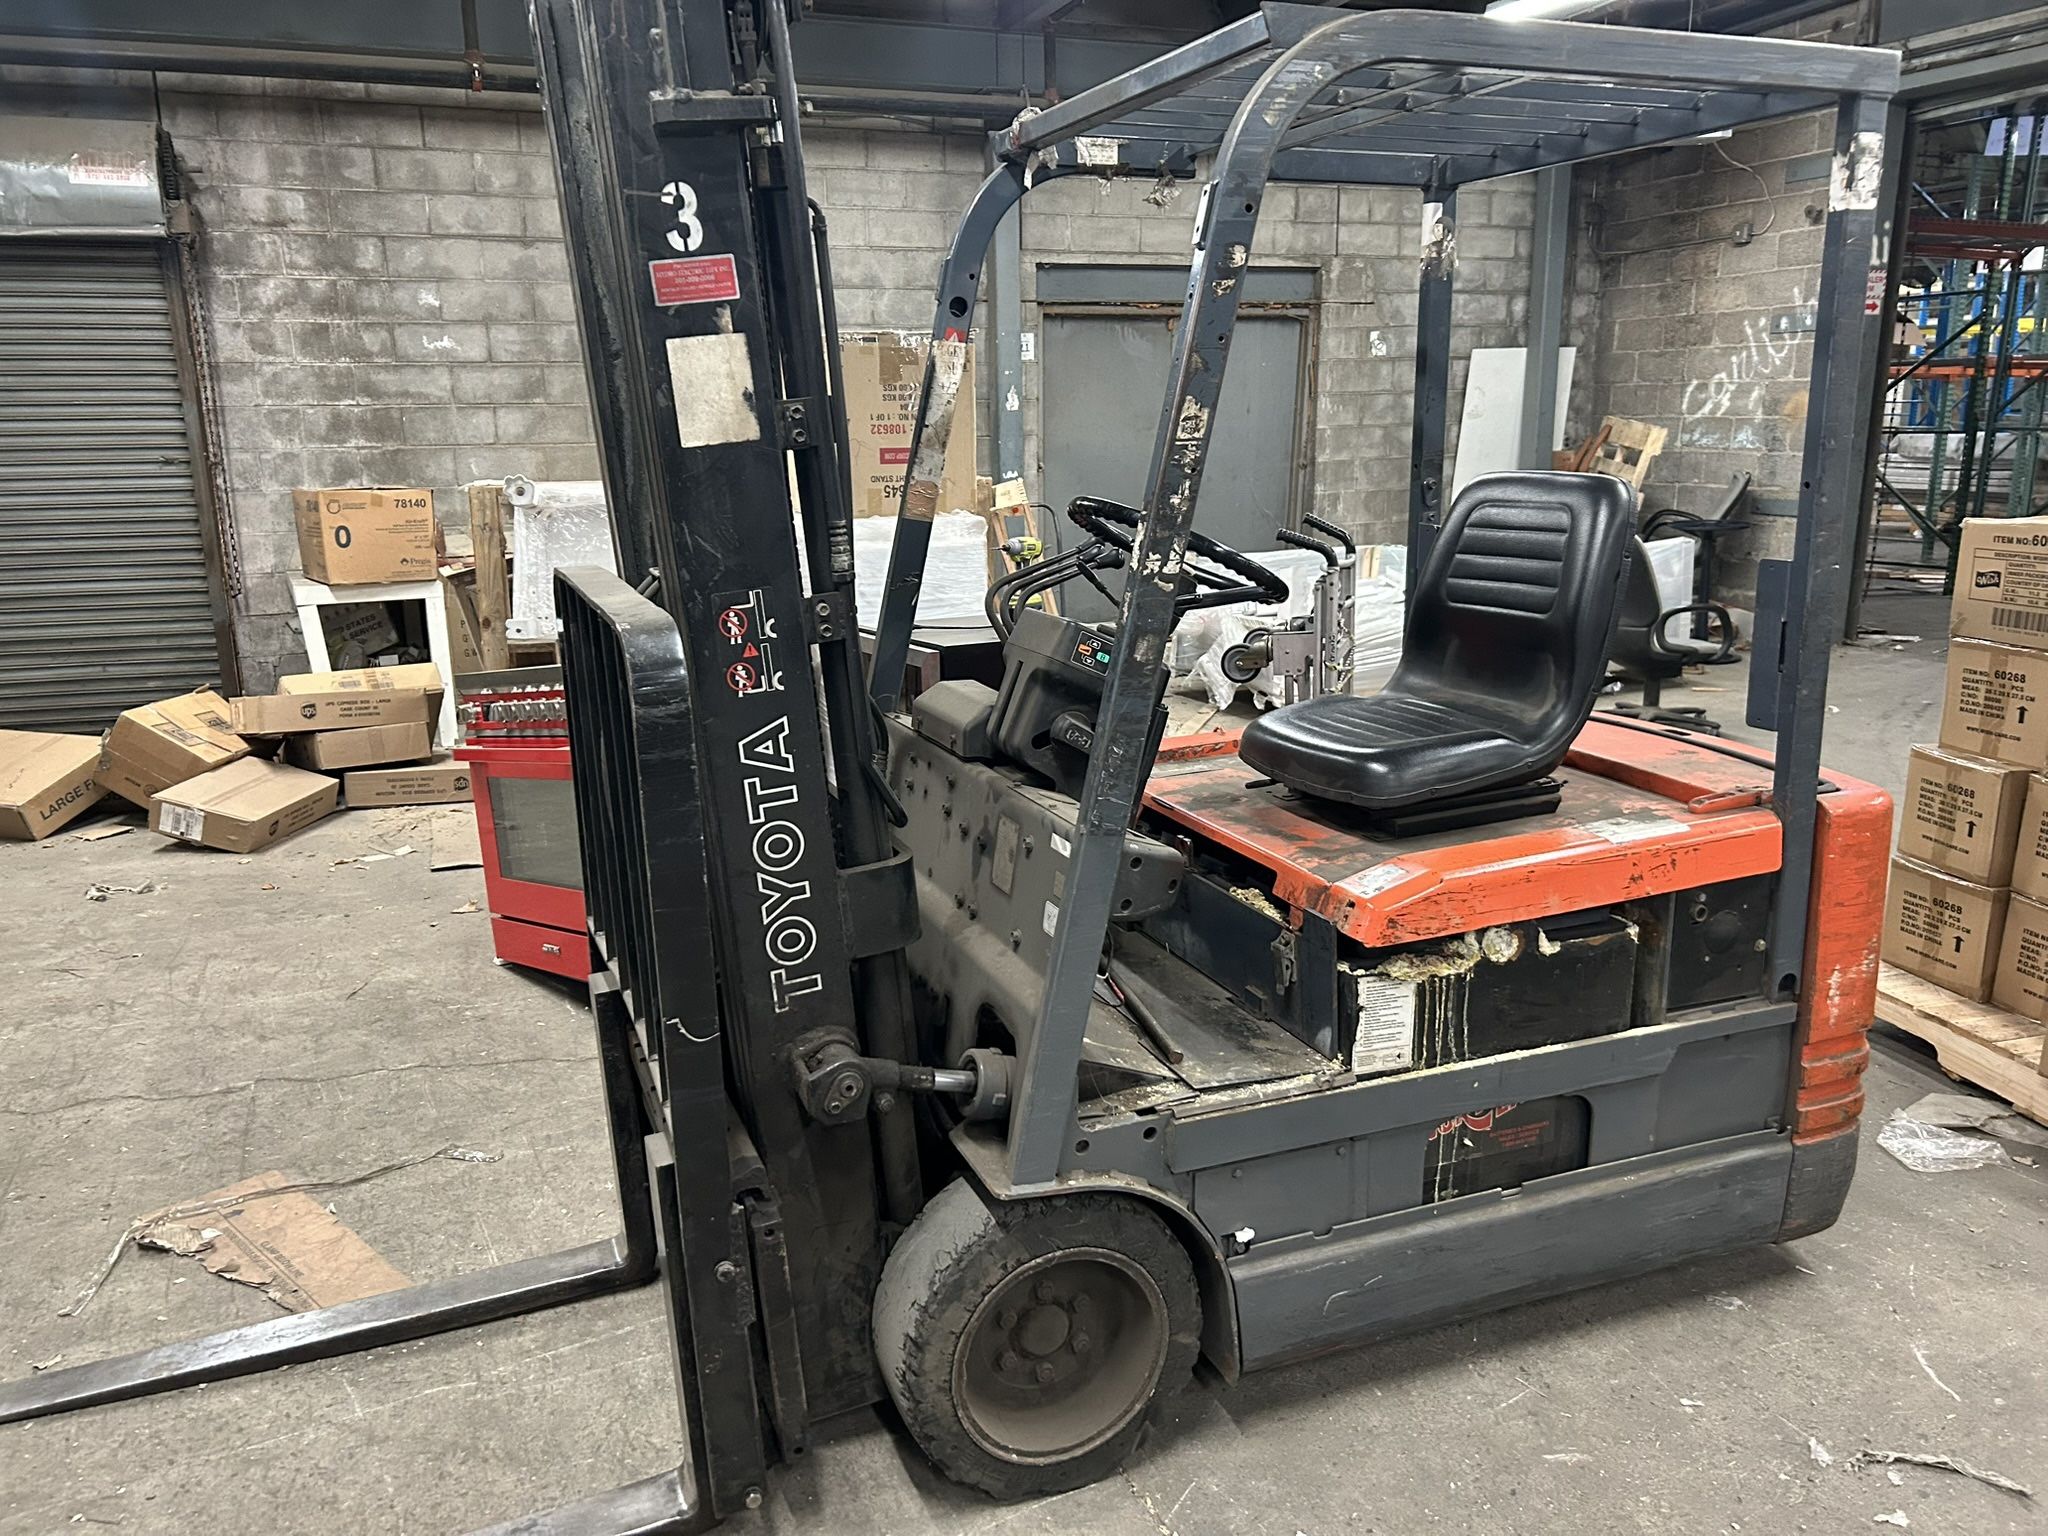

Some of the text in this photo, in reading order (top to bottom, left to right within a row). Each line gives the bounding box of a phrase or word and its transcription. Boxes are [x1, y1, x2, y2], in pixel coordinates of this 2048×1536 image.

[661, 181, 703, 252] 3
[870, 424, 907, 434] 108632
[394, 498, 426, 508] 78140
[335, 525, 352, 548] 0
[1993, 535, 2014, 544] ITEM
[346, 614, 376, 630] STATES
[349, 621, 384, 639] SERVICE
[1994, 670, 2026, 683] 60268
[1960, 706, 1977, 714] MADE
[1985, 711, 2005, 720] CHINA
[1921, 778, 1933, 786] ITEM
[1947, 783, 1975, 799] 60268
[39, 784, 84, 820] LARGE
[1917, 814, 1931, 824] MADE
[1939, 821, 1956, 832] CHINA
[738, 714, 823, 1013] TOYOTA
[1904, 890, 1917, 898] ITEM
[1932, 898, 1962, 915] 60268
[1900, 926, 1916, 936] MADE
[1924, 935, 1942, 946] CHINA
[2023, 928, 2039, 939] ITEM
[2016, 966, 2036, 978] MADE
